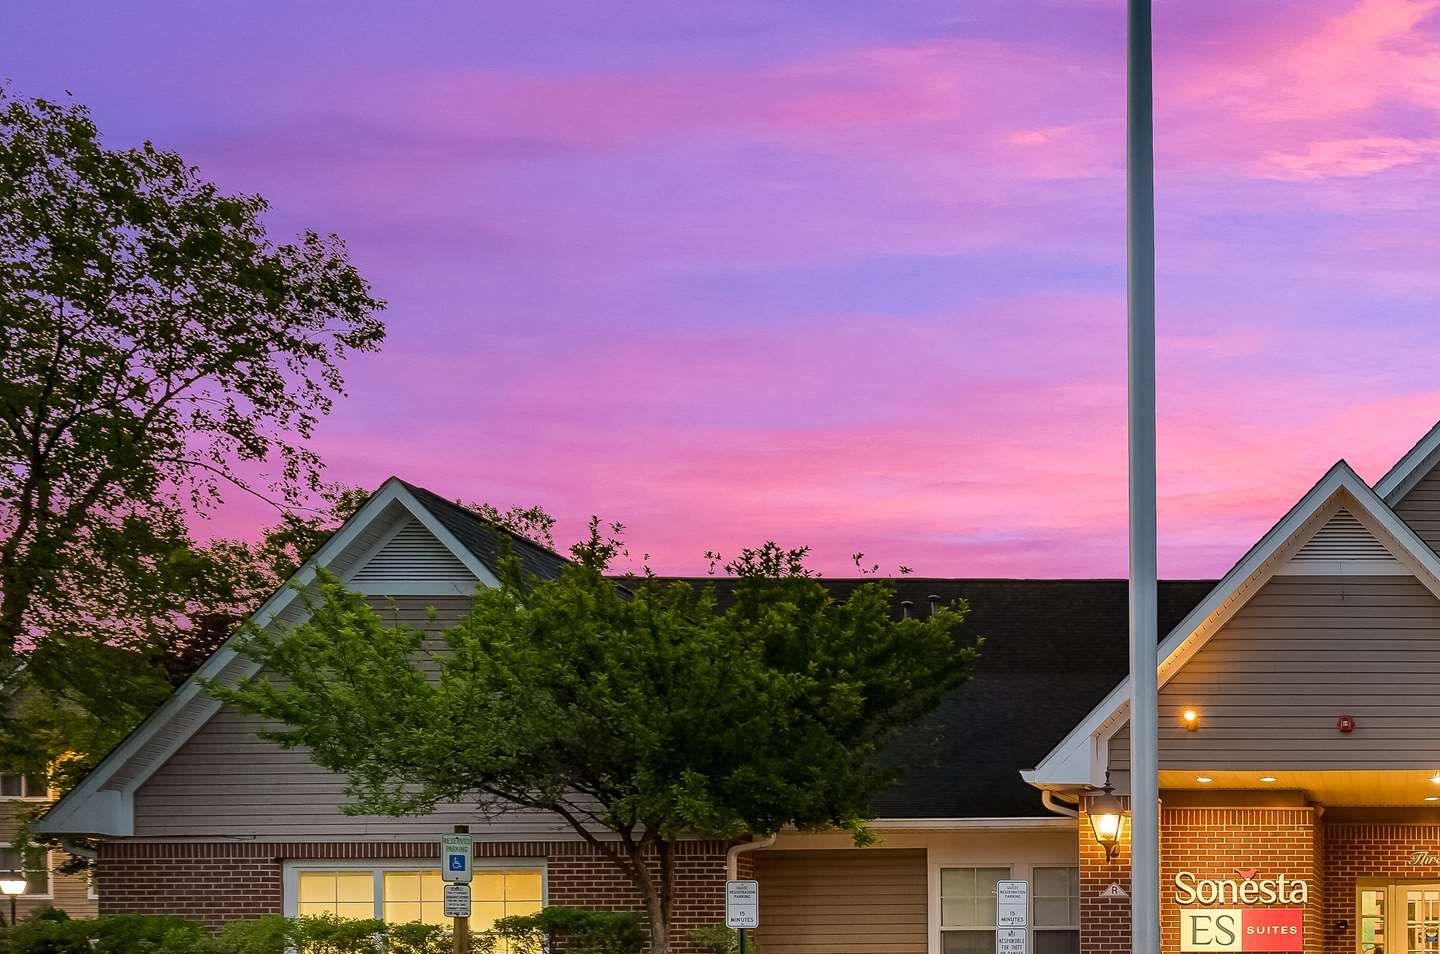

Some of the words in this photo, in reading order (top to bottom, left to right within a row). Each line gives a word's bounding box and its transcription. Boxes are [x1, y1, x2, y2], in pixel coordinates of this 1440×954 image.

[1111, 886, 1118, 895] R
[1189, 914, 1236, 946] ES
[1246, 926, 1298, 935] SUITES
